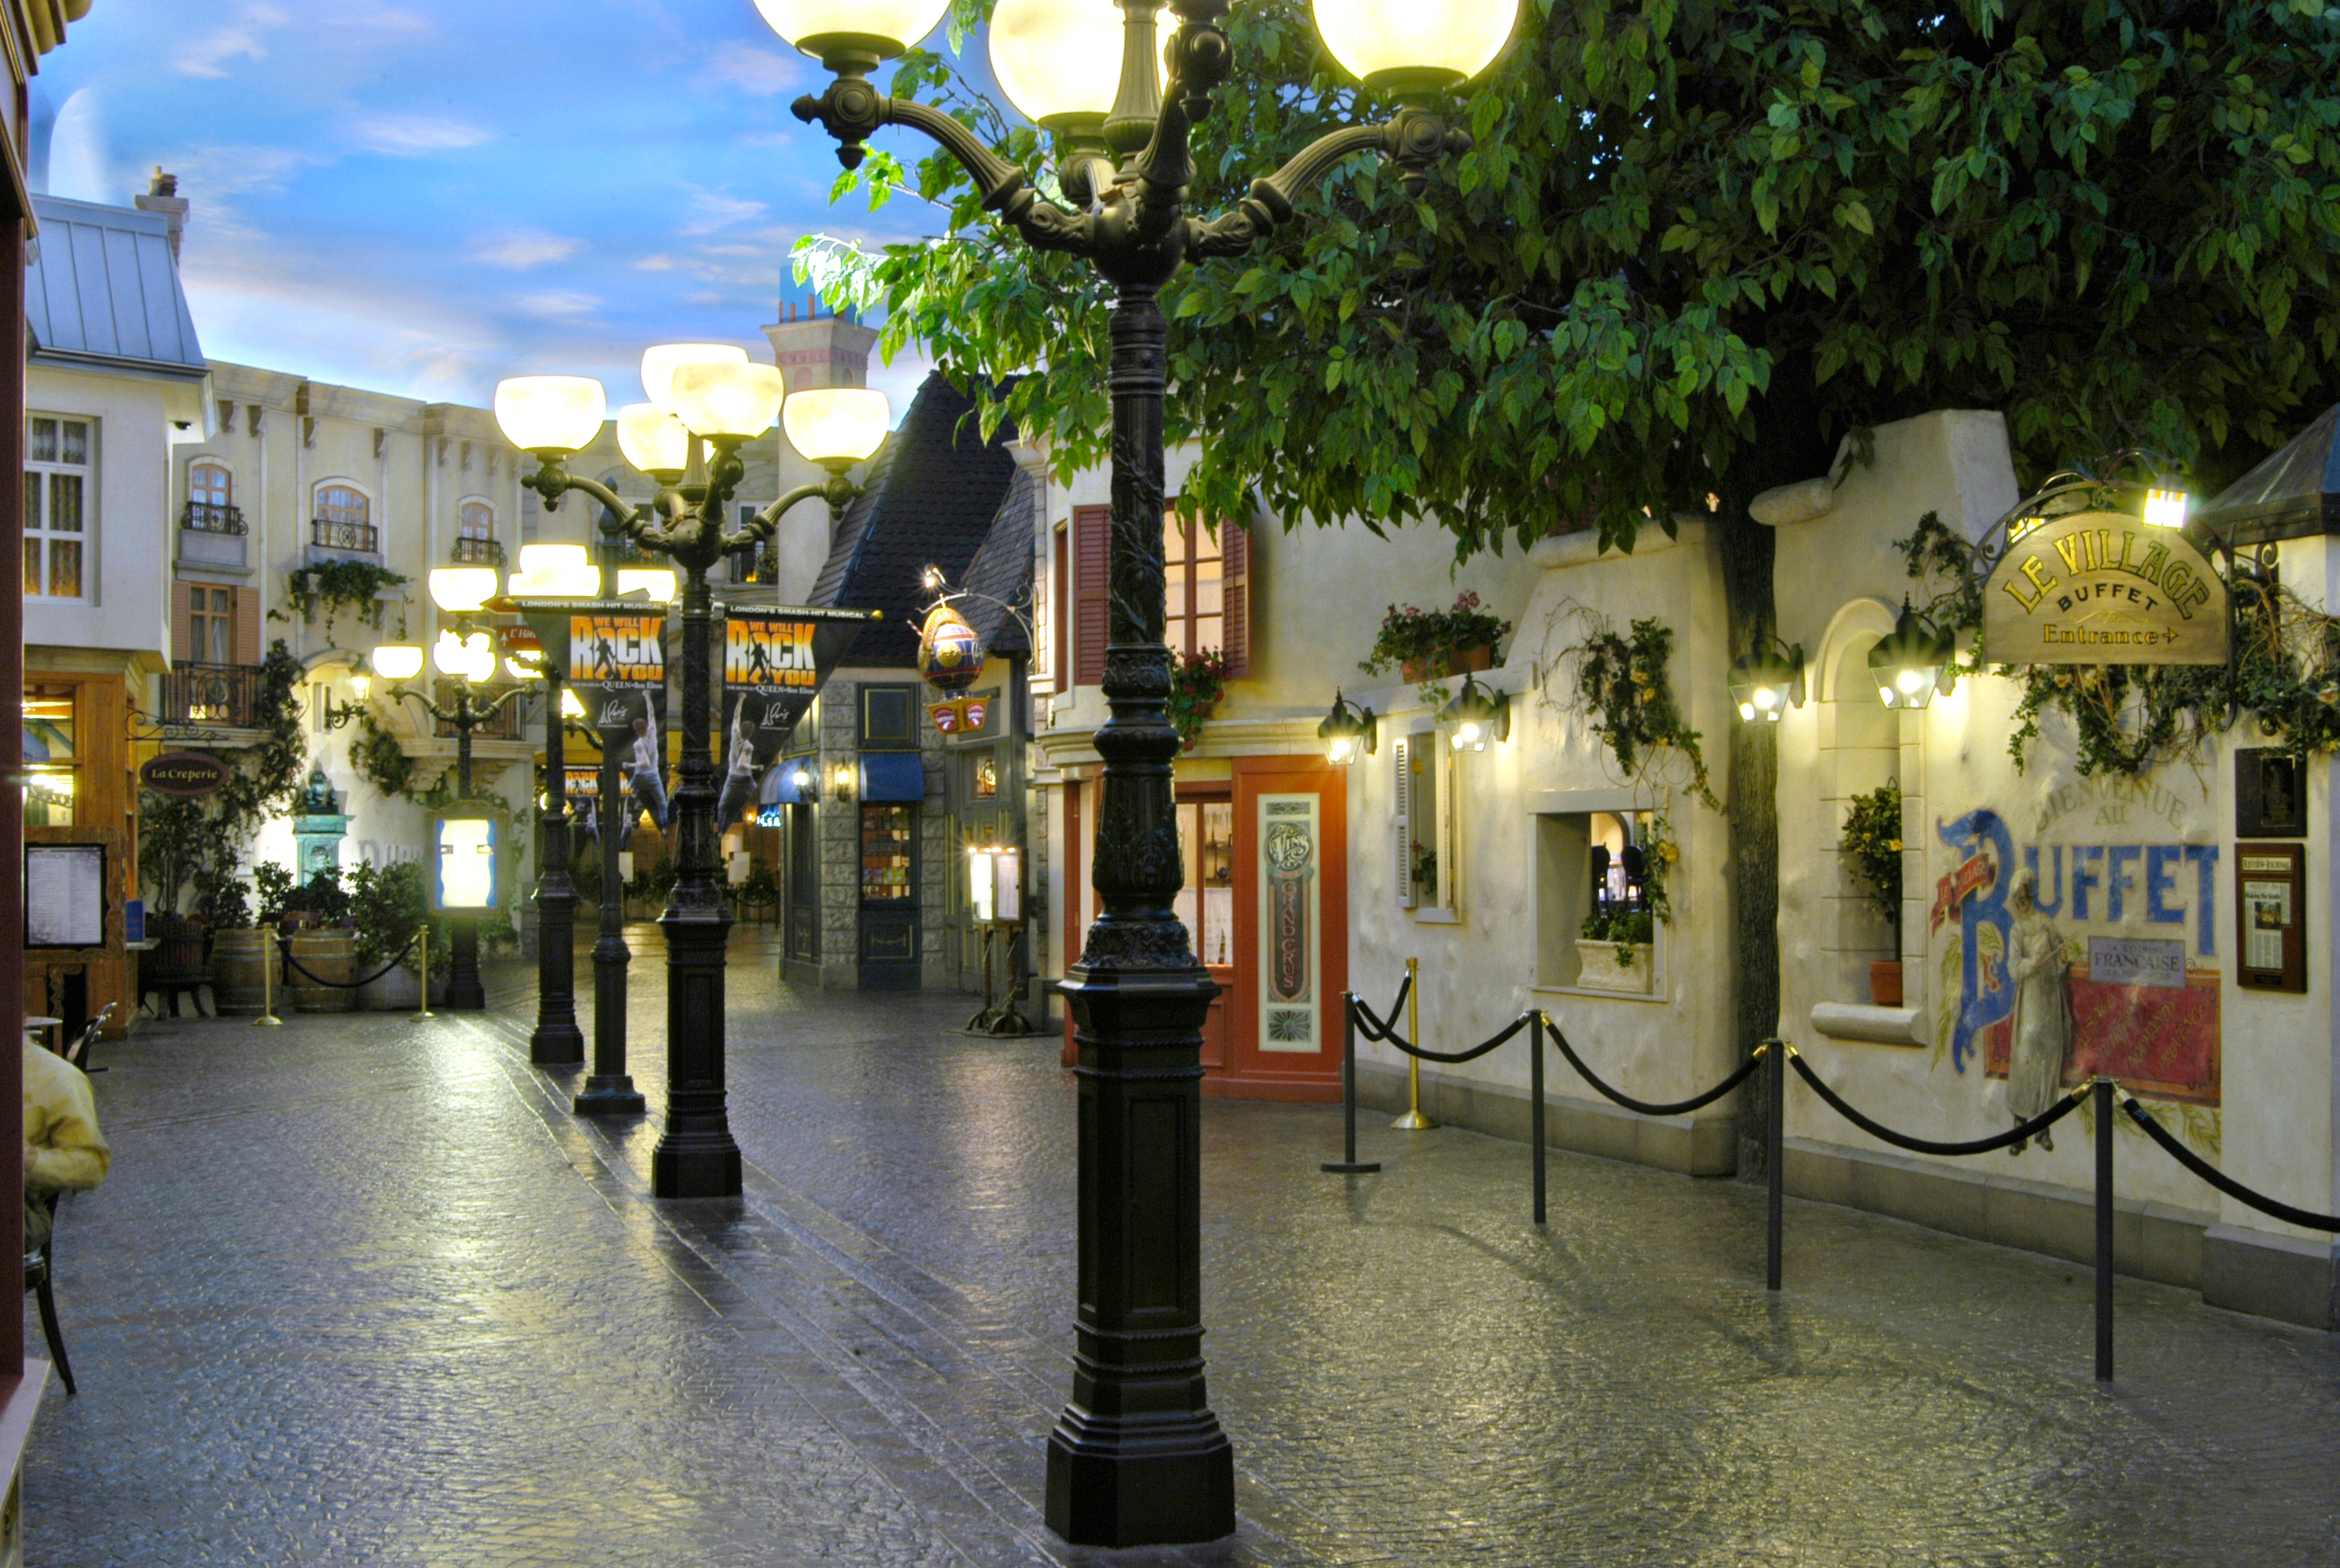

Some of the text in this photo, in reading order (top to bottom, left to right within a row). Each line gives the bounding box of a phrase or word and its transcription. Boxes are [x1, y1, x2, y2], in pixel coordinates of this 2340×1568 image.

[2003, 529, 2211, 620] LE VILLAGE
[2057, 582, 2160, 613] BUFFET
[594, 617, 639, 628] WE WILL
[730, 606, 865, 619] LONDON'S SMASH-HIT MUSICAL
[749, 621, 793, 634] WE WILL
[2043, 624, 2160, 645] Entrance
[570, 616, 664, 680] ROCK
[726, 620, 817, 684] ROCK
[617, 664, 664, 681] YOU
[770, 669, 817, 686] YOU
[602, 681, 631, 693] QUEEN
[755, 684, 785, 697] QUEEN
[151, 769, 218, 783] La Creperie
[2034, 773, 2188, 832] BIENVENUE
[2093, 804, 2128, 826] AU
[1281, 881, 1296, 937] GRAND
[1937, 807, 2220, 1074] BUFFET
[1281, 938, 1296, 988] CRUS
